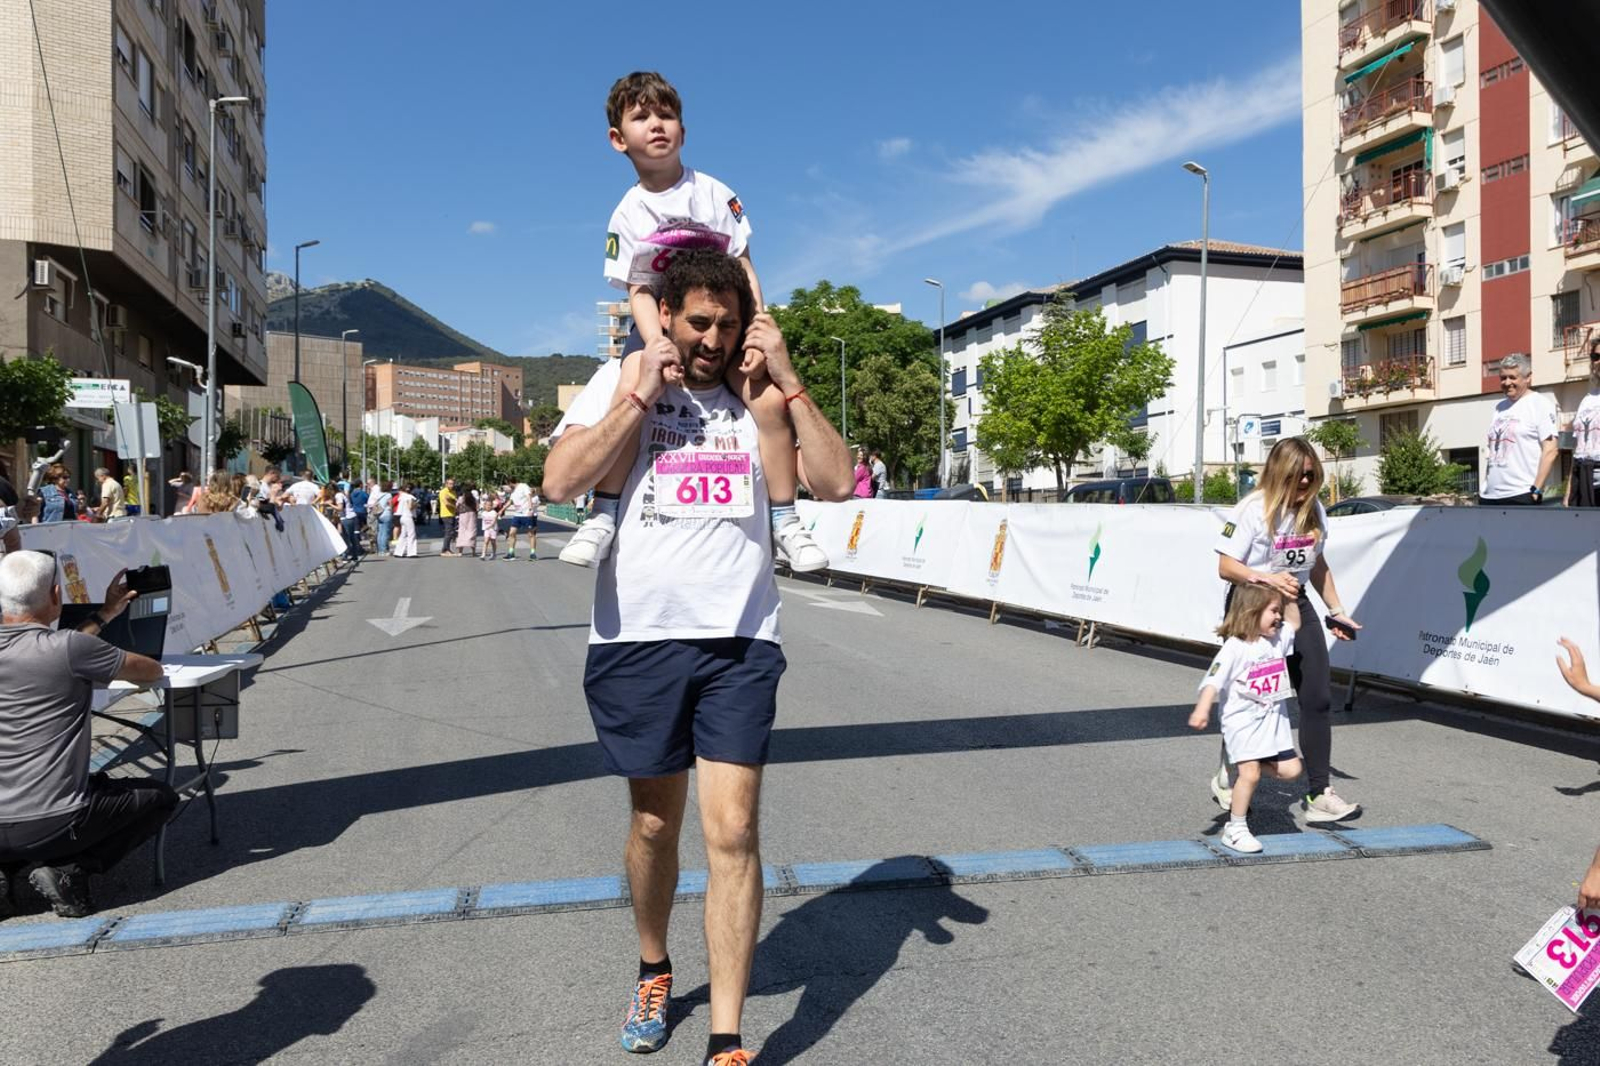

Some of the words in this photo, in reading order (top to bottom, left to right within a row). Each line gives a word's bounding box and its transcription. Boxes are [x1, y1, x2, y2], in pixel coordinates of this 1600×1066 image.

[651, 427, 687, 446] IRON
[676, 475, 732, 504] 613
[1286, 549, 1306, 565] 95
[1419, 630, 1457, 646] Patronato
[1458, 636, 1501, 653] Municipal
[1502, 645, 1515, 655] de
[1423, 643, 1462, 659] Deportes
[1464, 652, 1476, 662] de
[1478, 653, 1500, 666] Jaén
